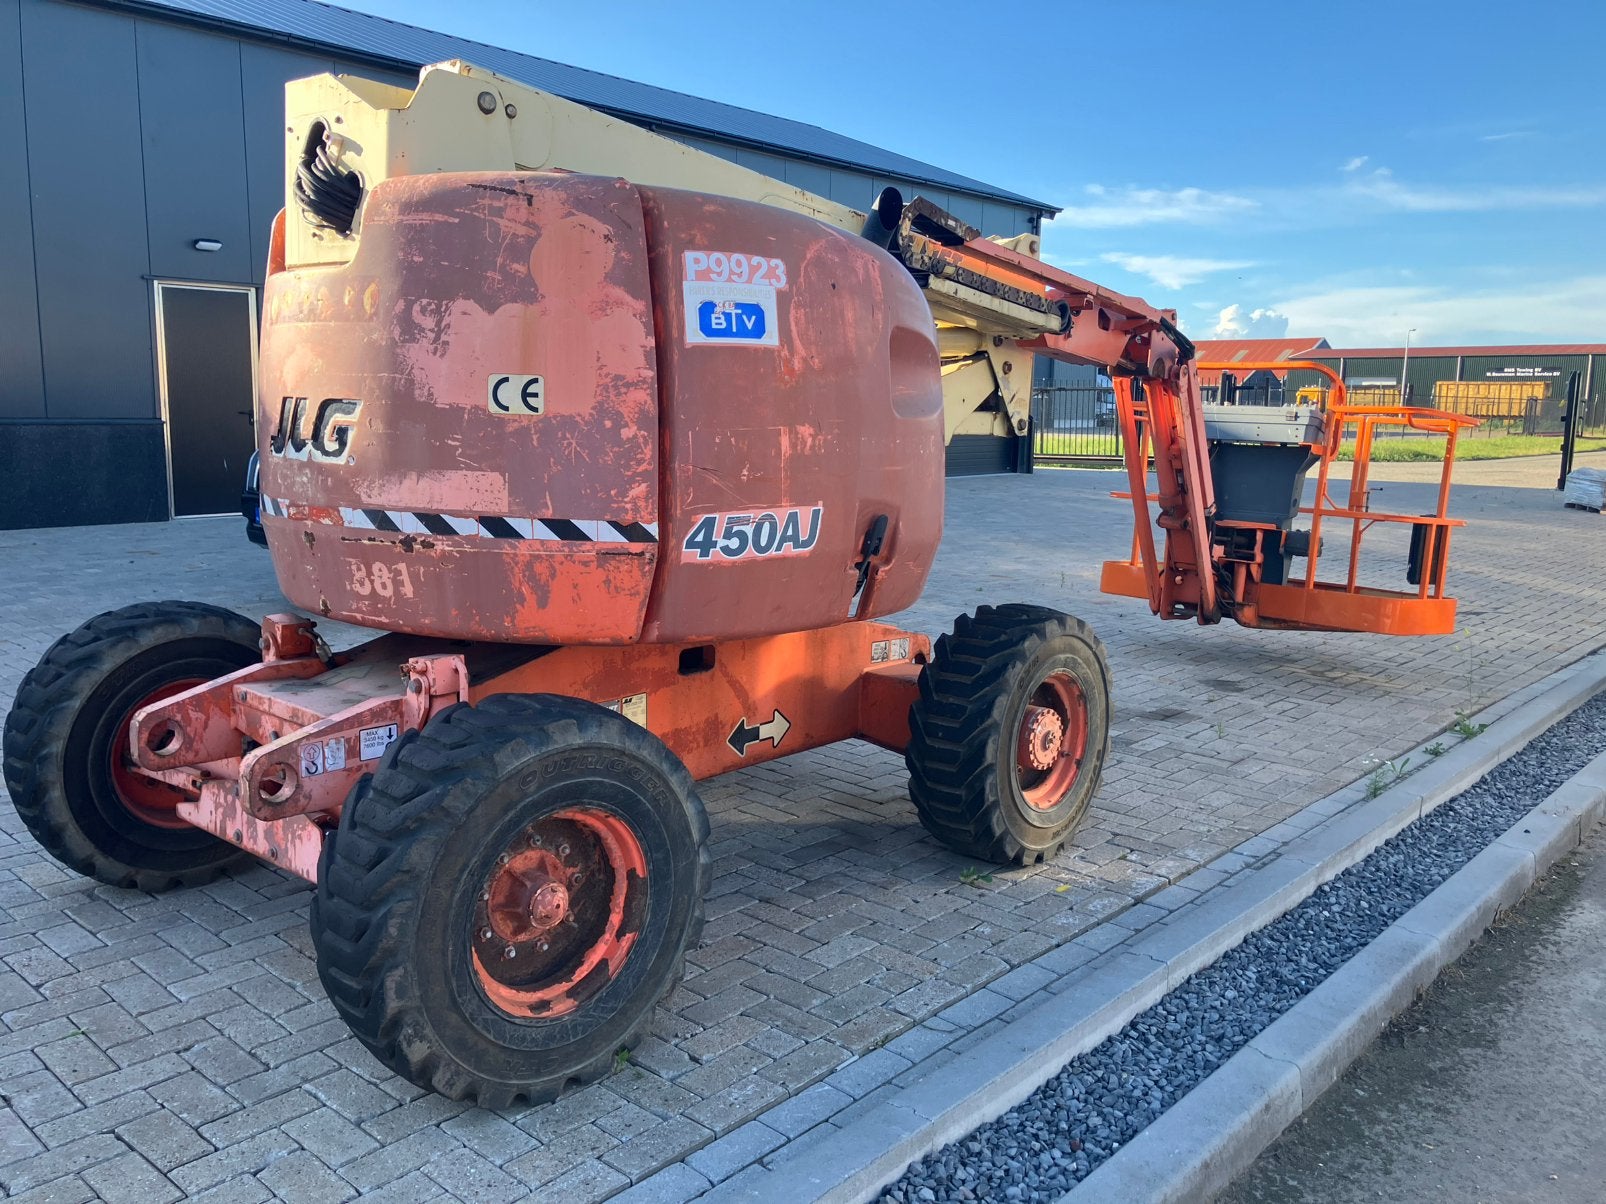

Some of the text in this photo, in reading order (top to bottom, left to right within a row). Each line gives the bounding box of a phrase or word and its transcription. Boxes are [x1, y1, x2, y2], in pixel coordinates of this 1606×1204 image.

[685, 252, 787, 288] P9923
[492, 376, 539, 413] CE
[269, 396, 363, 464] JLG
[683, 506, 824, 561] 450AJ
[519, 752, 668, 808] OUTRIGGER
